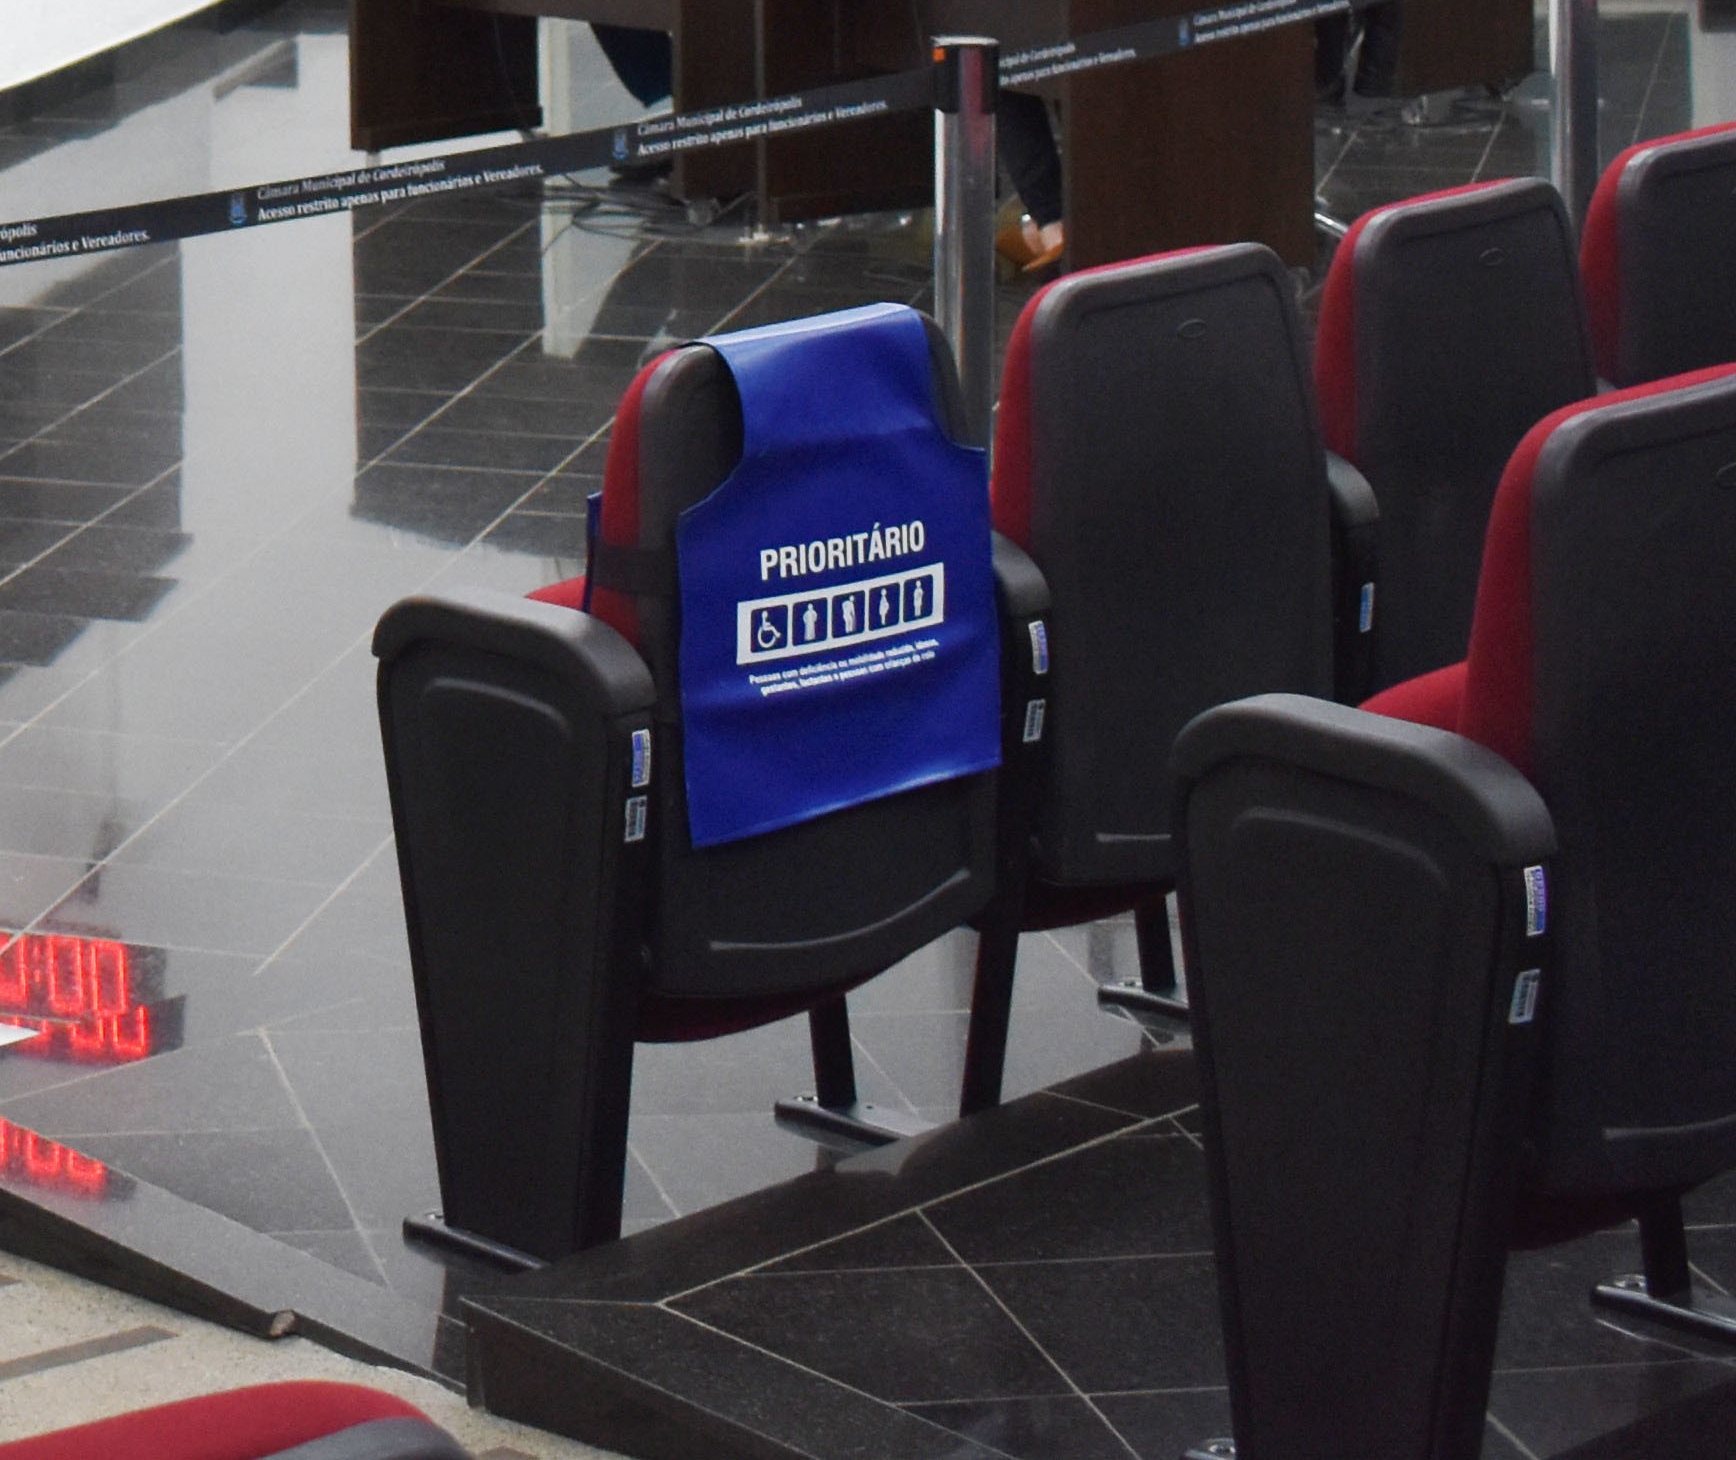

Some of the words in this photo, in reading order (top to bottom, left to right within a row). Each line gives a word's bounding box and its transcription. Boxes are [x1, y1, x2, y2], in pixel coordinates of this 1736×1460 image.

[257, 183, 300, 201] Câmara
[302, 170, 357, 193] Municipal
[358, 168, 372, 184] de
[257, 204, 296, 222] Acesso
[297, 195, 341, 216] restrito
[341, 189, 380, 210] apenas
[381, 186, 406, 205] para
[407, 174, 474, 197] funcionários
[72, 240, 79, 253] e
[759, 519, 926, 582] PRIORITÁRIO
